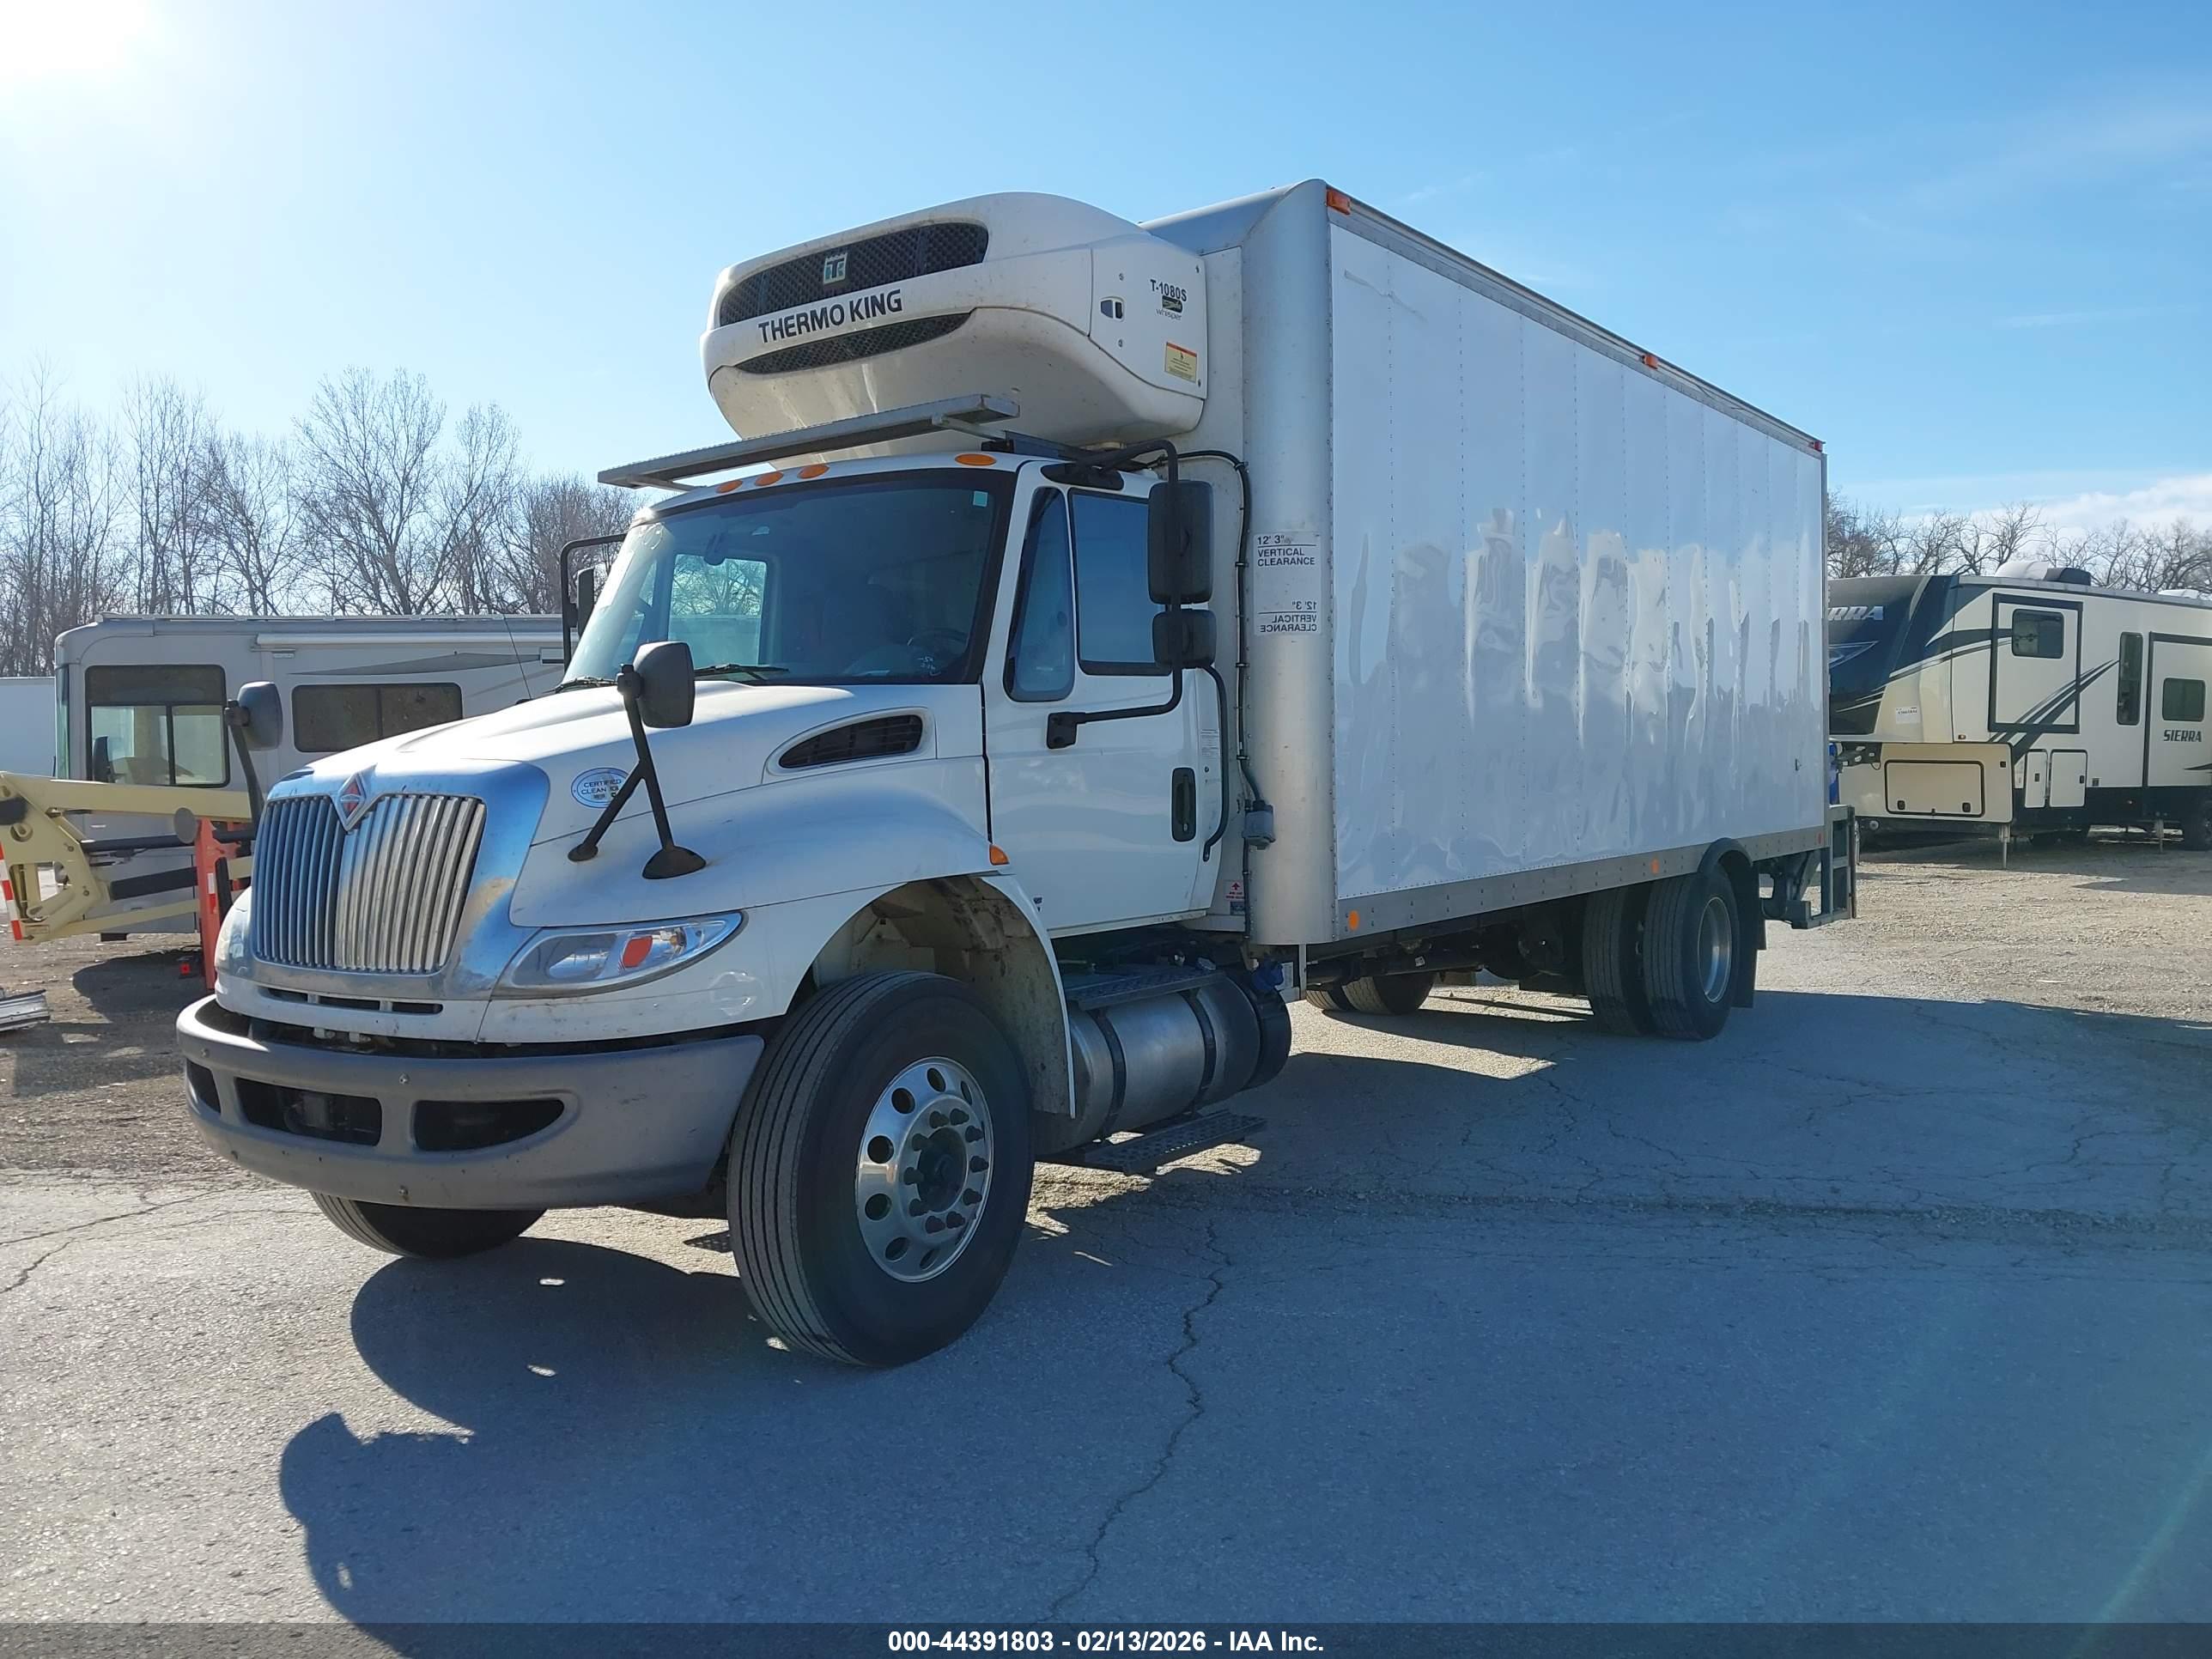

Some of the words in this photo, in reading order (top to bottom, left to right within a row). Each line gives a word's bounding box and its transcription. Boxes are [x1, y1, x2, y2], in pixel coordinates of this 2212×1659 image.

[1150, 279, 1187, 302] T-1080S
[757, 303, 845, 343] THERMO
[848, 289, 902, 323] KING
[1257, 535, 1271, 545] 12'
[1257, 549, 1304, 557] VERTICAL
[1257, 556, 1316, 567] CLEARANCE
[2164, 730, 2202, 742] SIERRA
